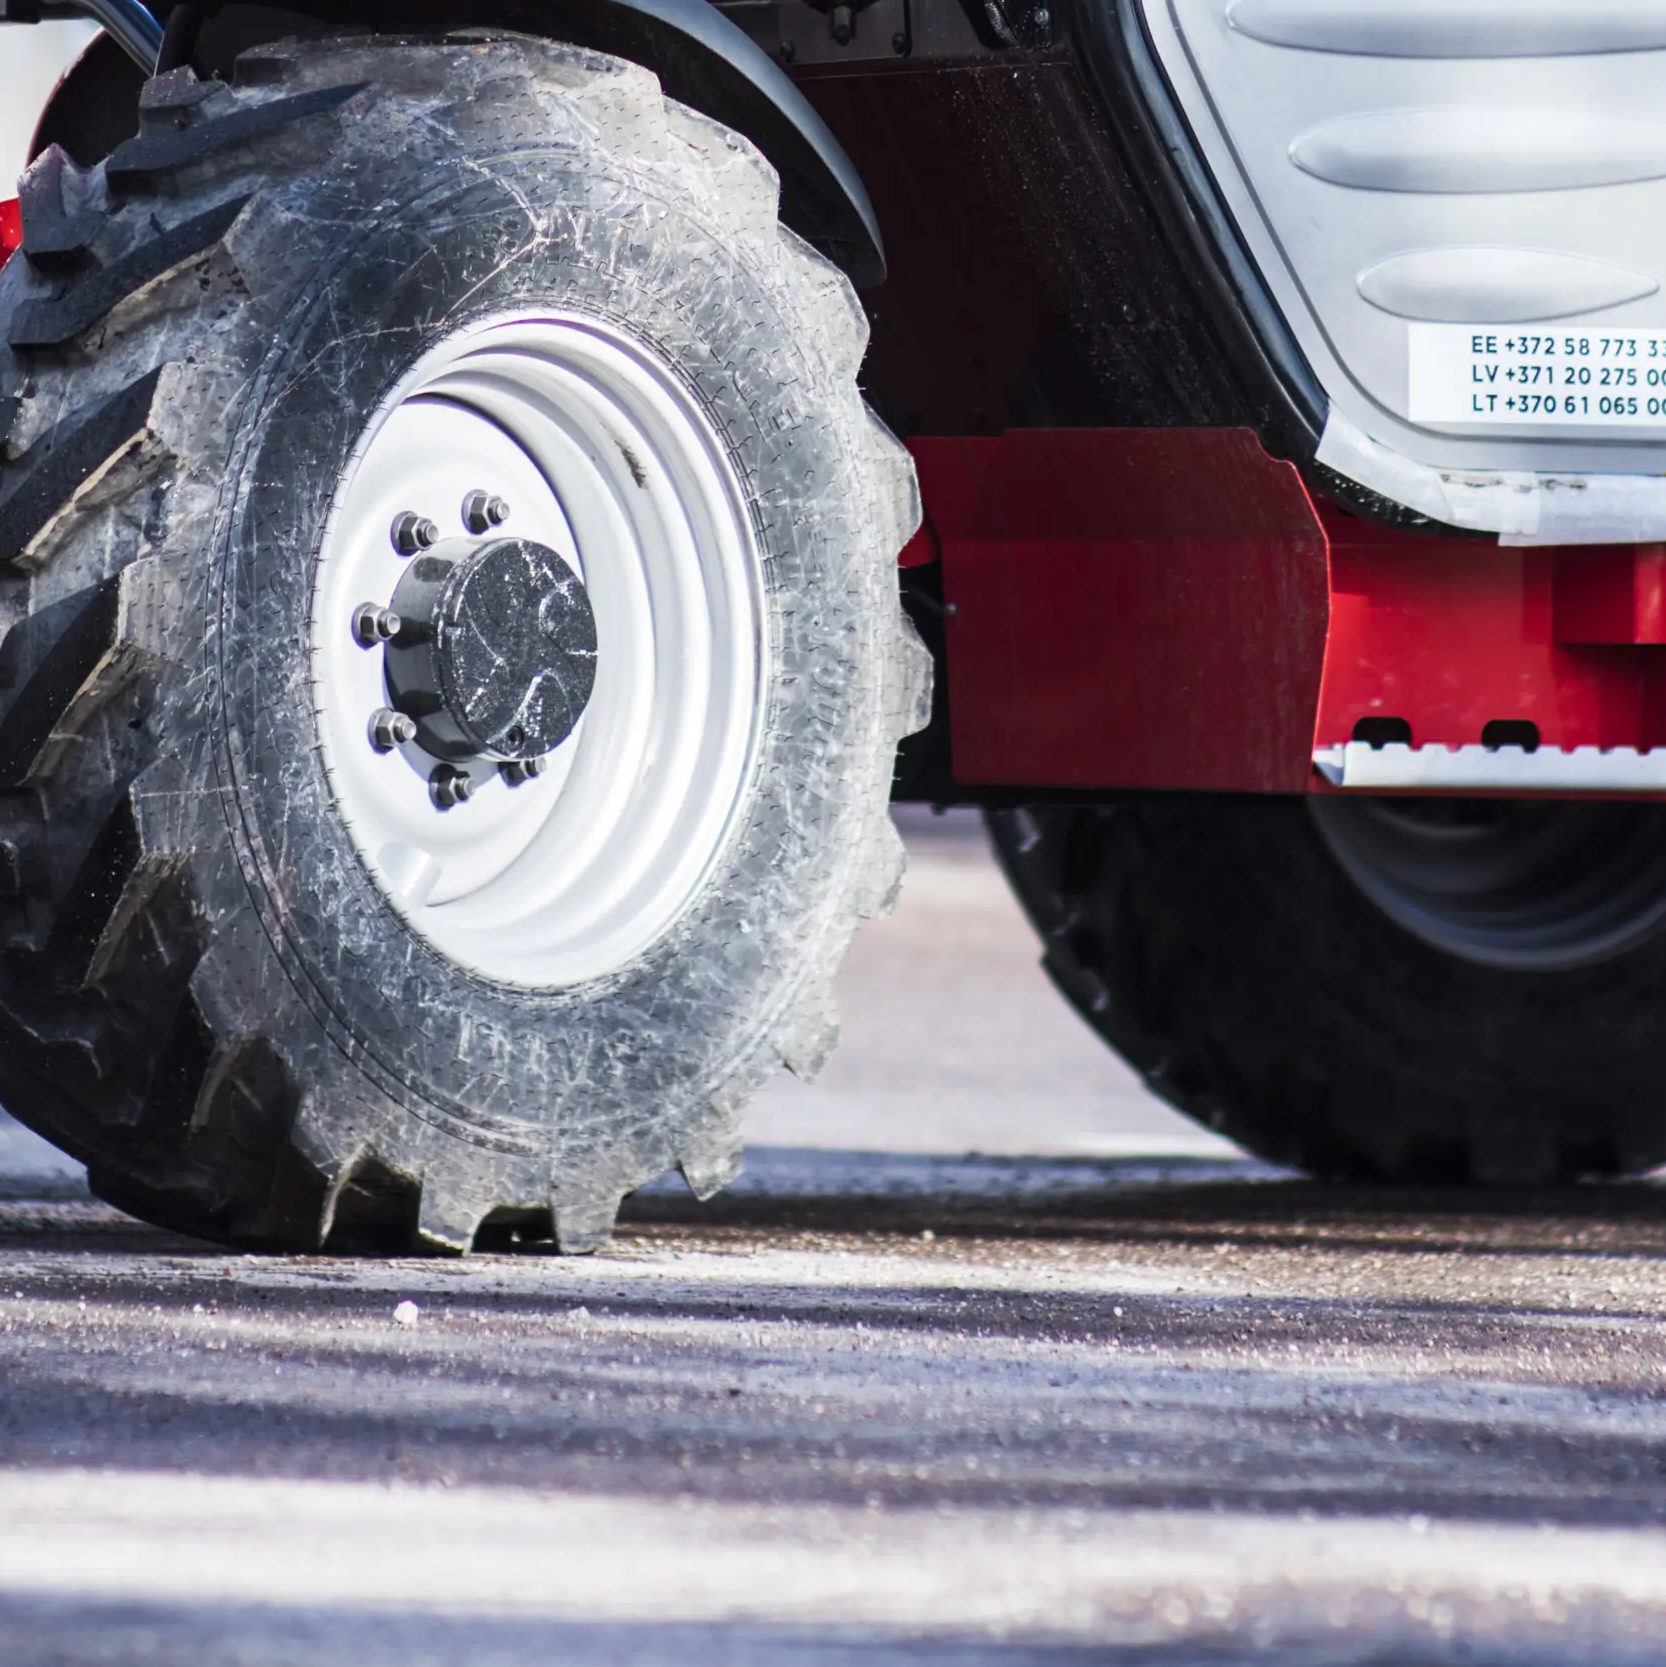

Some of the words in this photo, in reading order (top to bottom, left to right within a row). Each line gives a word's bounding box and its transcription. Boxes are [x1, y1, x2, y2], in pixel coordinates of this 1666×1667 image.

[1472, 336, 1497, 353] EE
[1505, 337, 1555, 355] +372
[1564, 338, 1590, 355] 58
[1600, 339, 1636, 356] 773
[1472, 365, 1498, 383] LV
[1505, 366, 1554, 384] +371
[1564, 367, 1591, 385] 20
[1600, 368, 1637, 386] 275
[1472, 394, 1498, 412] LT
[1505, 395, 1556, 413] +370
[1564, 396, 1589, 414] 61
[1599, 397, 1638, 415] 065
